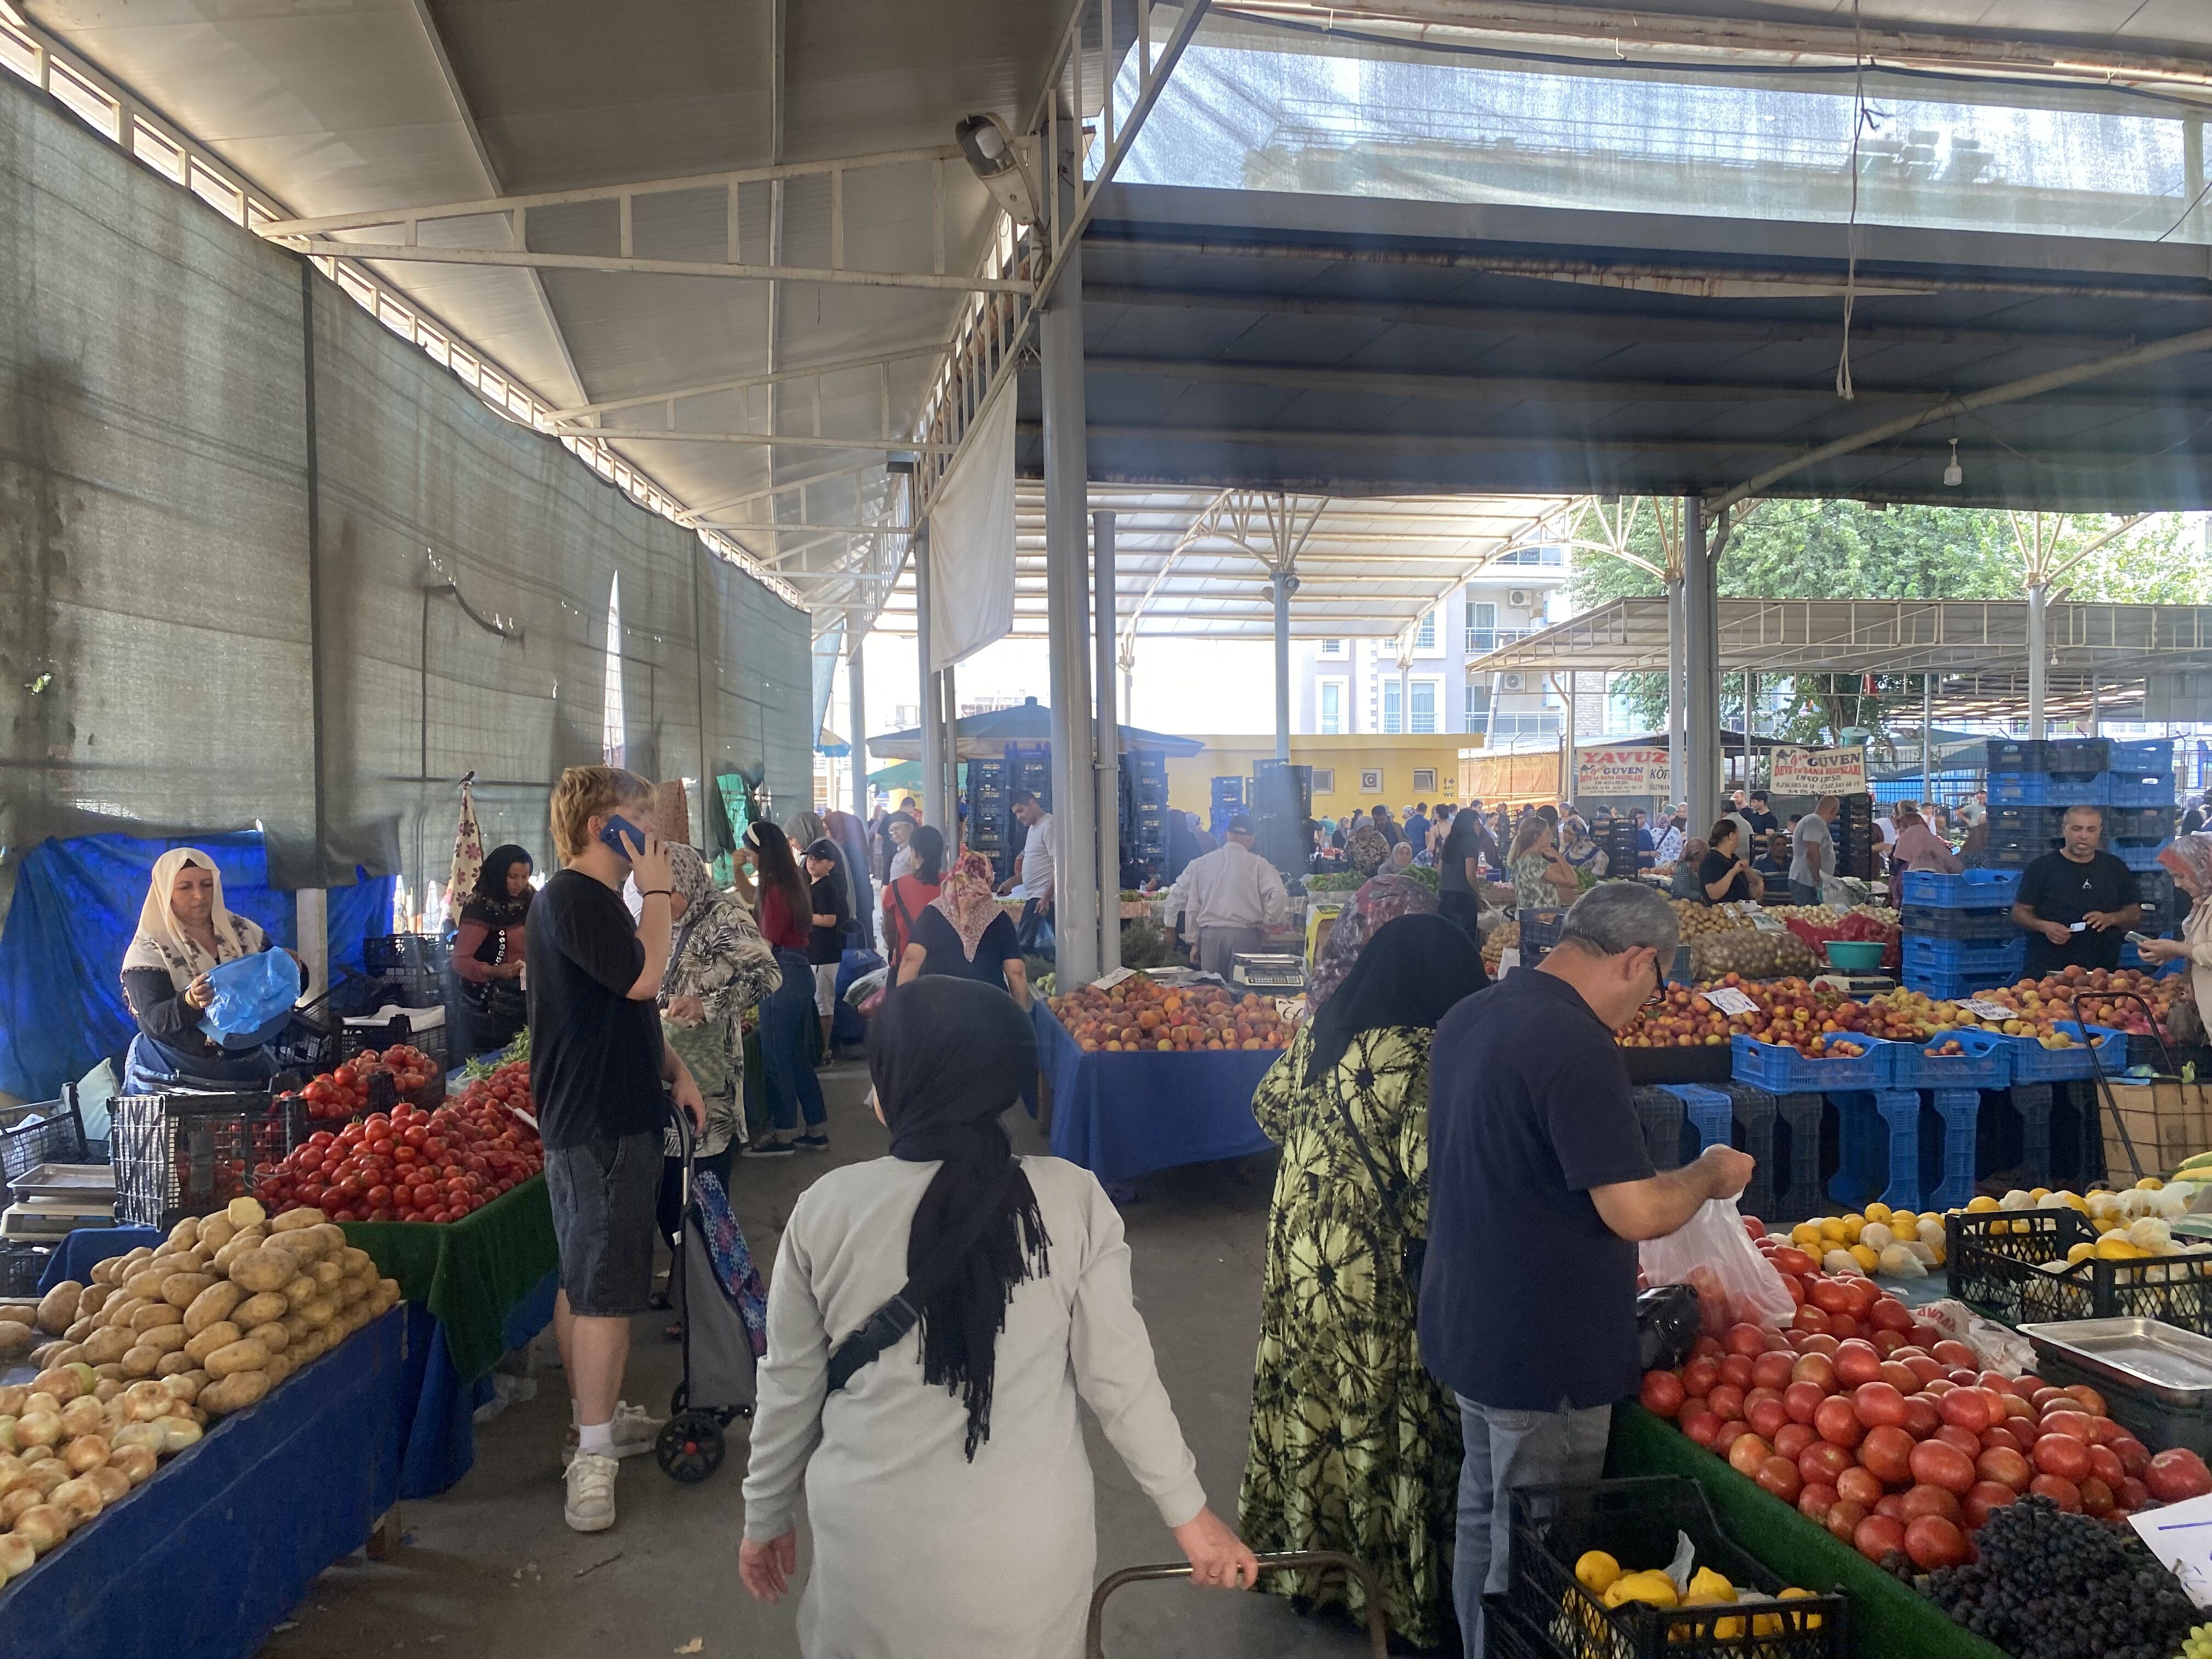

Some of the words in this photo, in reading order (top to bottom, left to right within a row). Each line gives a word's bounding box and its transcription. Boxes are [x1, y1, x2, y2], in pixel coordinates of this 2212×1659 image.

[1583, 752, 1668, 764] YAVUZ
[1807, 753, 1861, 767] GÜVEN
[1603, 766, 1644, 775] GÜVEN
[1774, 764, 1793, 776] DEVE
